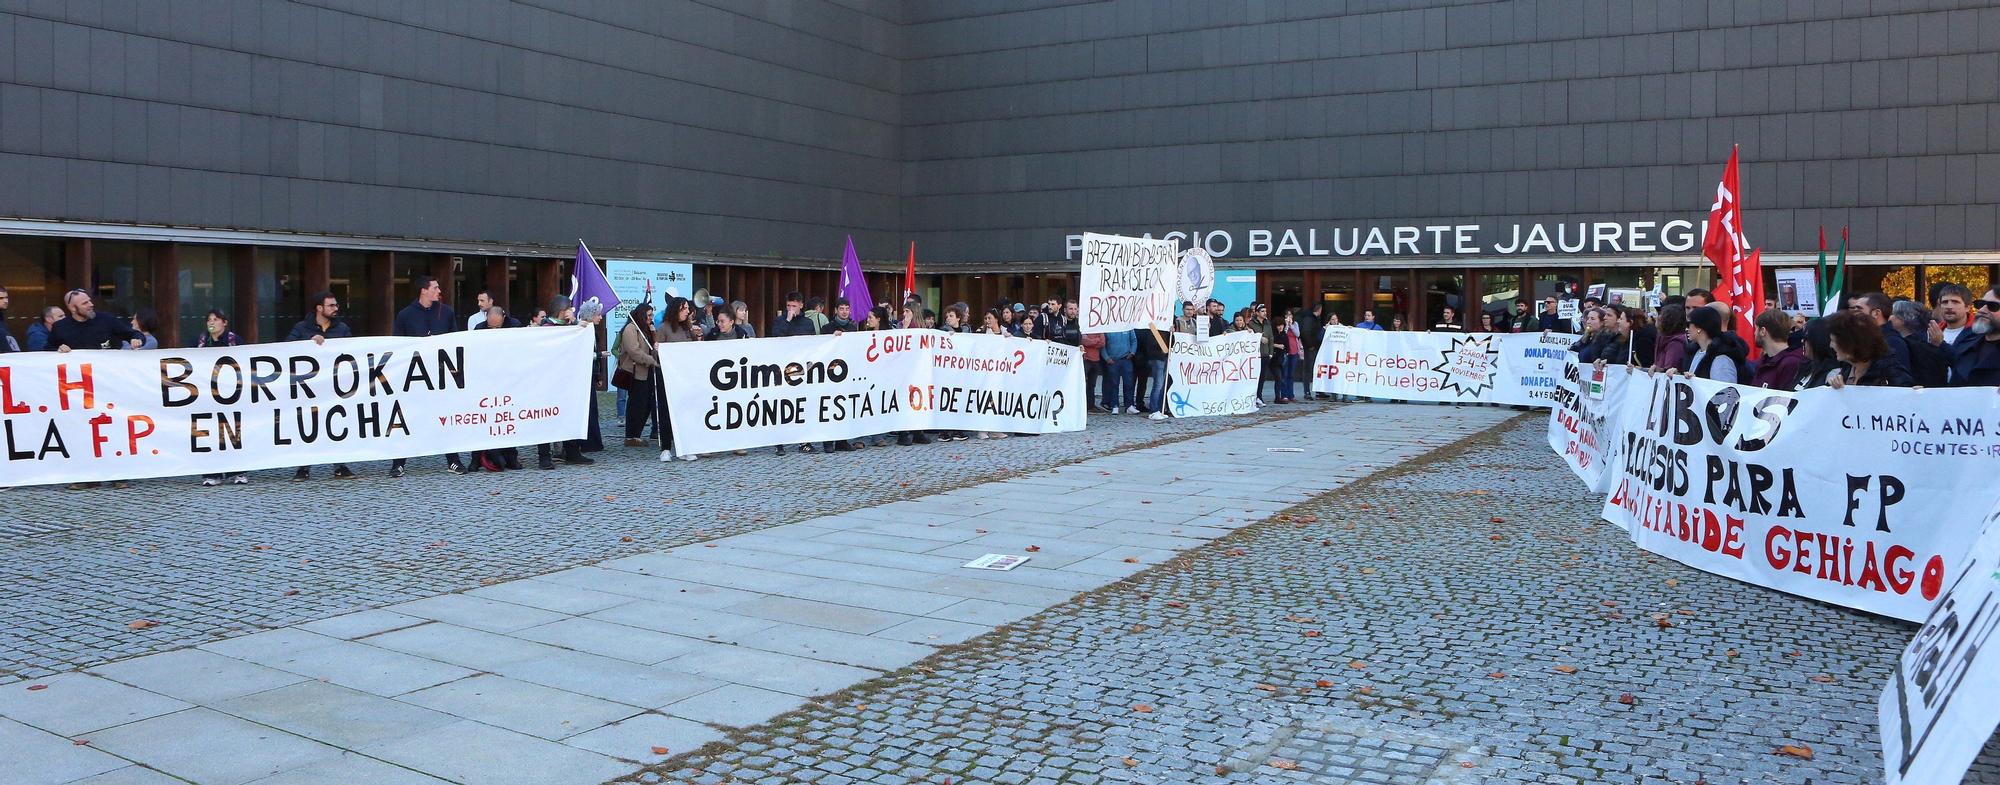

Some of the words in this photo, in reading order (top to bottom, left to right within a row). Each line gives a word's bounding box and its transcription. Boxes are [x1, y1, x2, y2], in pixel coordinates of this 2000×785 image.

[1066, 229, 1232, 259] PCIO
[1248, 224, 1480, 257] BALUARTE
[1494, 219, 1751, 254] JAUREGI
[920, 334, 936, 350] NO
[940, 336, 953, 349] ES
[932, 350, 1025, 374] MPROVISACIÓN?
[1335, 350, 1359, 366] LH
[1365, 353, 1430, 371] Greban
[1456, 357, 1487, 373] 3-4-5
[1458, 349, 1489, 361] AZAROAK
[160, 346, 465, 407] BORROKAN
[1316, 364, 1339, 380] FP
[1345, 371, 1368, 384] en
[1375, 372, 1439, 391] huelga
[1450, 366, 1486, 381] NOVIEMBRE
[479, 395, 514, 408] C.I.P.
[704, 393, 807, 431] ¿DÓNDE
[819, 384, 876, 423] ESTÁ
[881, 389, 900, 414] LA
[940, 387, 963, 413] DE
[438, 413, 488, 426] VIRGEN
[494, 411, 515, 424] DEL
[518, 406, 560, 420] CAMINO
[1872, 413, 1930, 434] MARÍA
[1941, 418, 1985, 437] ANA
[4, 418, 70, 461] LA
[89, 413, 158, 458] F.P.
[191, 411, 243, 453] EN
[274, 400, 410, 445] LUCHA
[1704, 454, 1805, 519] PARA
[1843, 473, 1905, 533] FP
